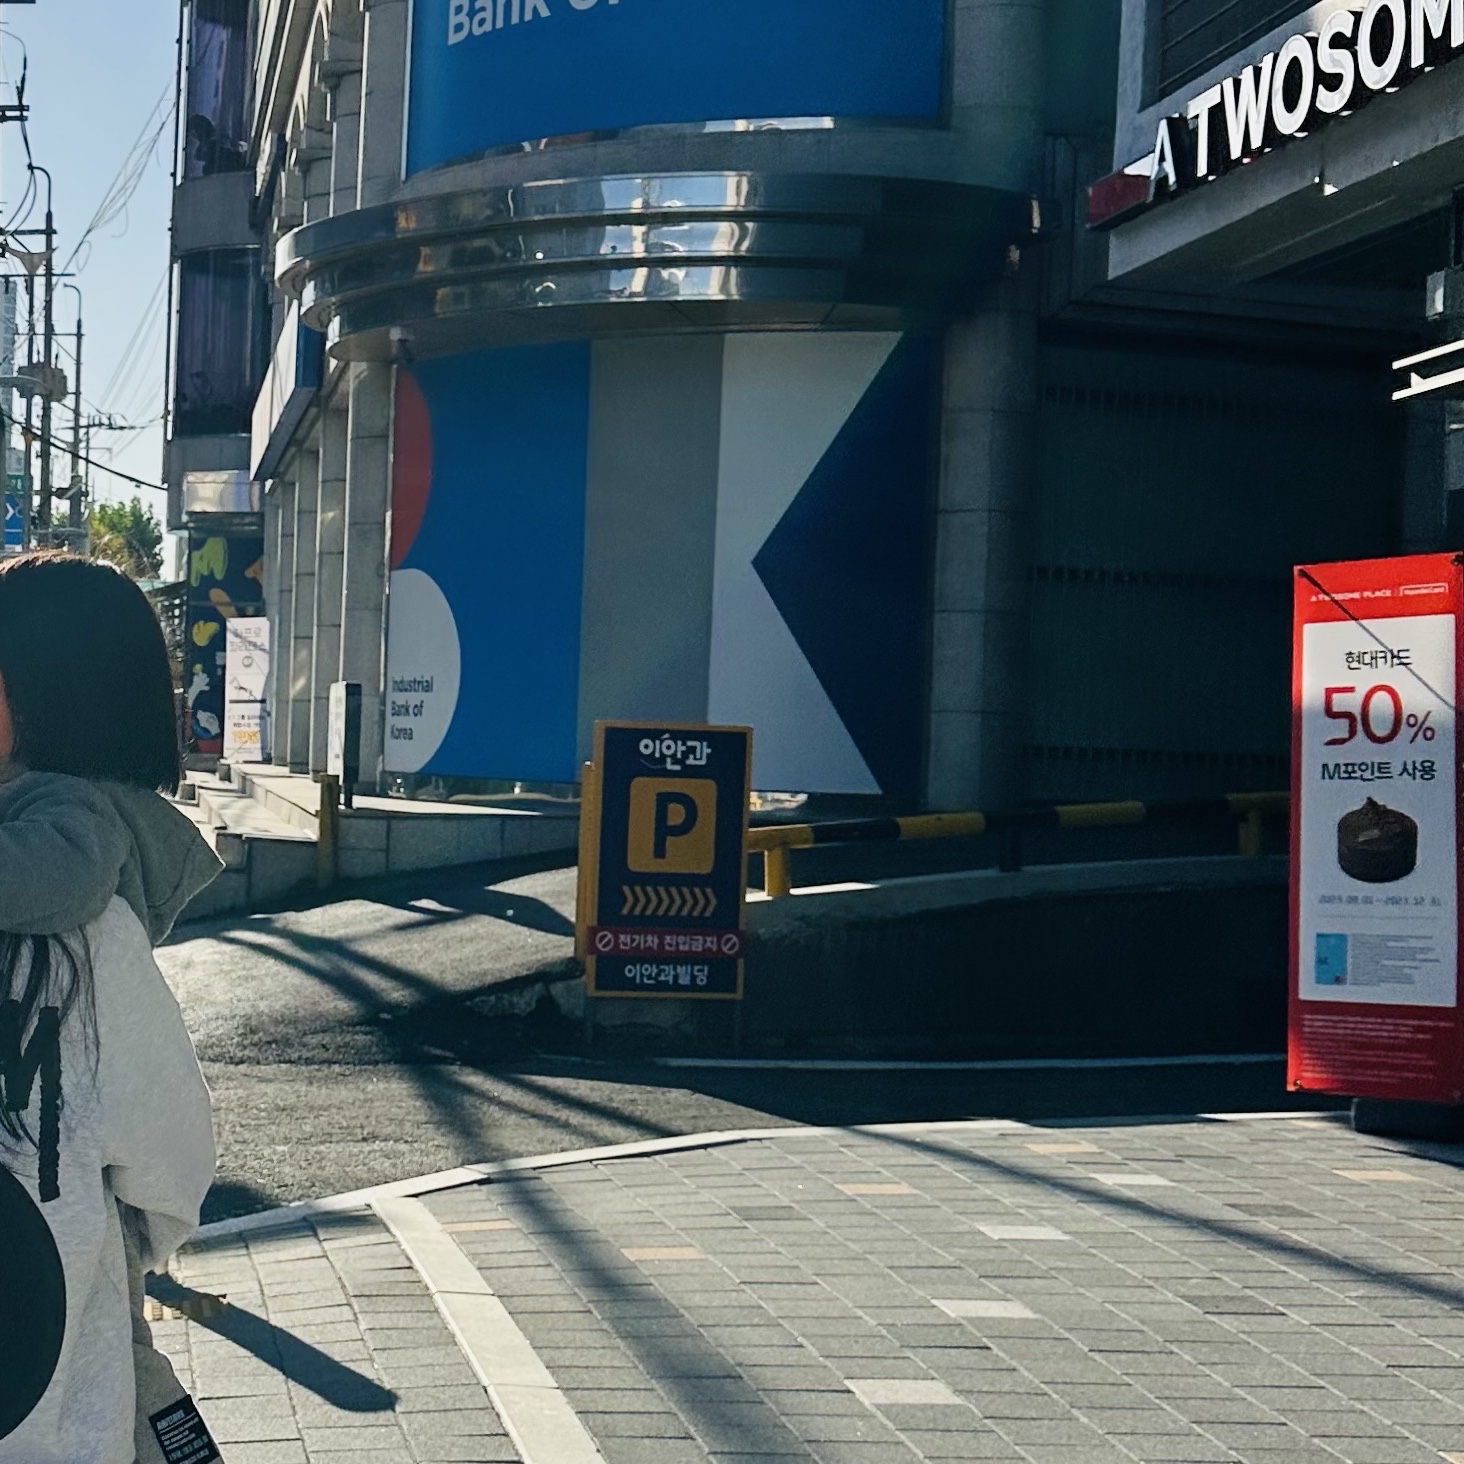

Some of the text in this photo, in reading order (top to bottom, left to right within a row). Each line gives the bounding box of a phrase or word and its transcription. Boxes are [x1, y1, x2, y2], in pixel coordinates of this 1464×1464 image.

[1147, 117, 1177, 202] A
[1345, 648, 1413, 670] 현대카드
[392, 675, 434, 693] Industrial
[391, 700, 425, 717] Bank of
[1323, 684, 1436, 746] 50%
[390, 724, 414, 741] Korea
[639, 734, 712, 771] 이안과
[1321, 759, 1437, 782] M포인트 사용
[653, 792, 698, 859] P
[618, 933, 718, 952] 전기차 진입금지
[624, 963, 710, 986] 이안과빌딩
